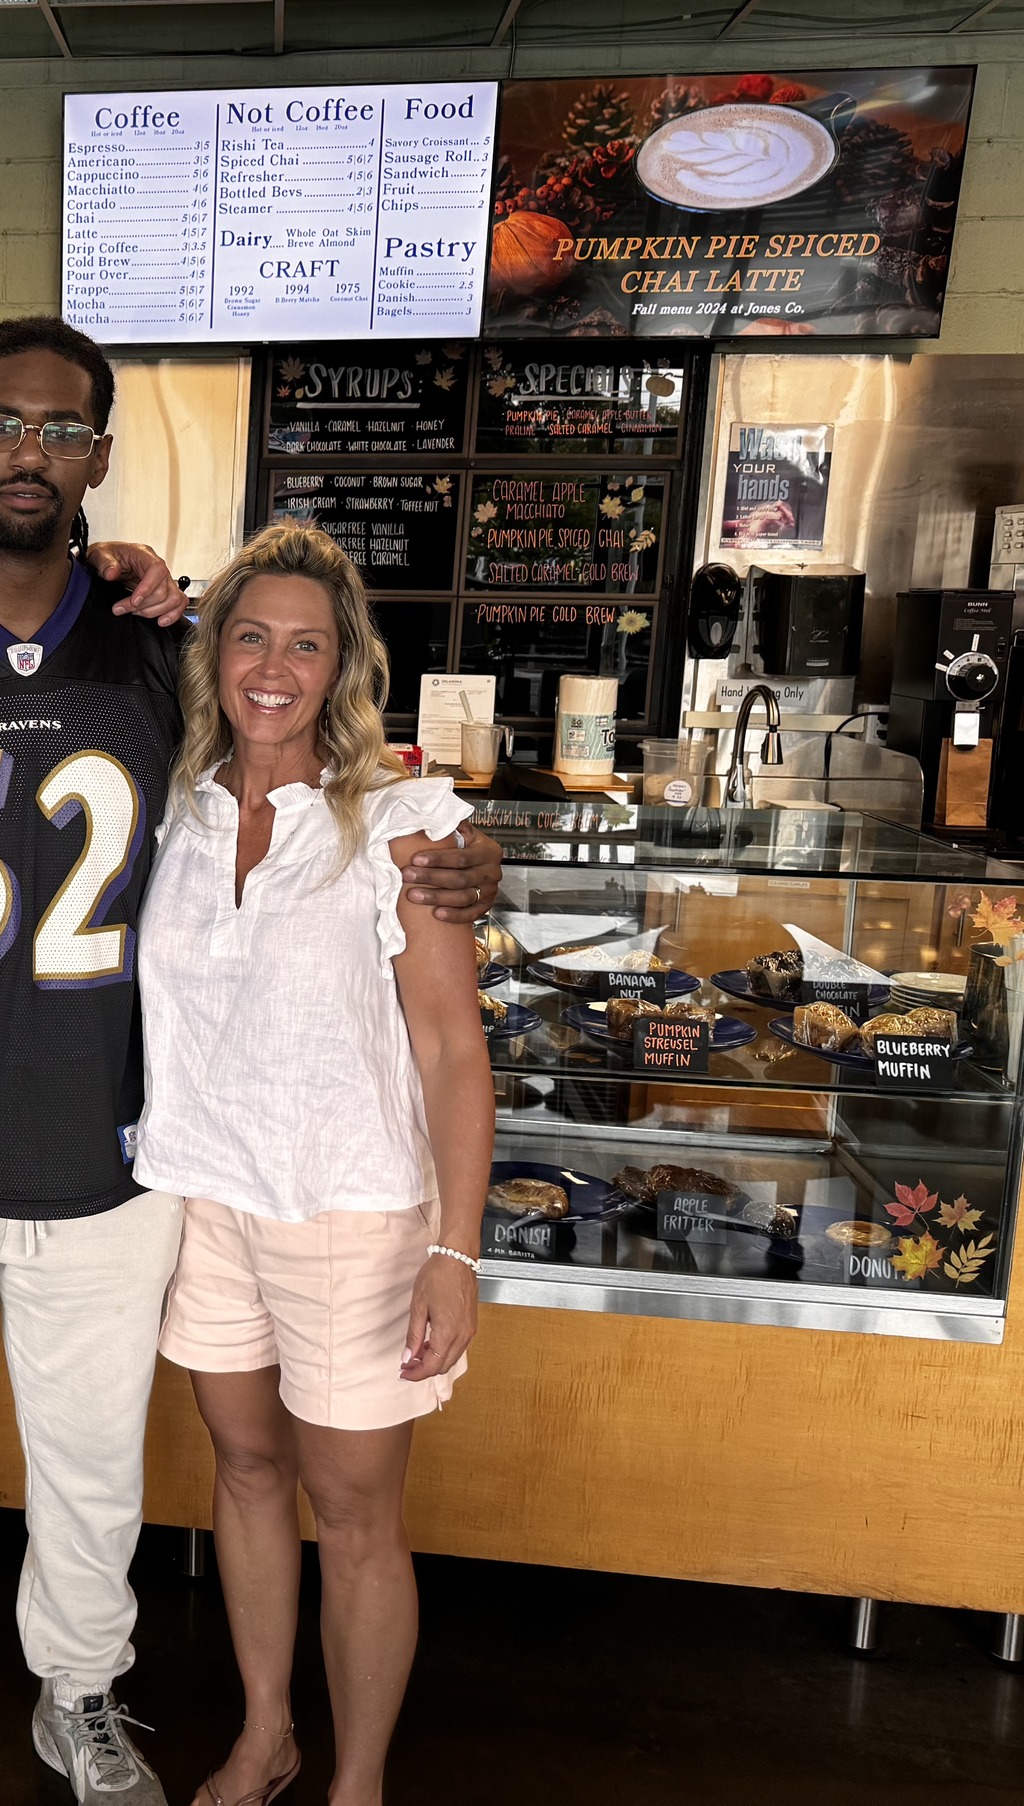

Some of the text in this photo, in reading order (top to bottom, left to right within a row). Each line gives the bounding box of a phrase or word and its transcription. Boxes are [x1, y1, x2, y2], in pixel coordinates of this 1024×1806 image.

[226, 98, 374, 124] Not Coffee
[404, 94, 474, 120] Food
[94, 105, 181, 130] Coffee
[221, 138, 284, 151] Rishi Tea
[385, 136, 490, 148] Savory Croissant 5
[68, 143, 126, 155] Espresso
[67, 156, 136, 167] Americano
[221, 154, 299, 169] Spiced Chai
[384, 150, 472, 164] Sausage Roll
[67, 169, 140, 182] Cappuccino
[220, 171, 285, 183] Refresher
[383, 167, 487, 179] Sandwich 7
[219, 186, 302, 199] Bottled Bevs
[383, 183, 415, 195] Fruit
[66, 199, 116, 210] Cortado
[218, 203, 273, 214] Steamer
[381, 199, 484, 212] Chips 2
[66, 213, 95, 224] Chai
[66, 228, 98, 239] Latte
[220, 227, 371, 249] Dairy Whole Oat Skim
[67, 243, 139, 255] Drip Coffee
[287, 238, 355, 248] Breve Almond
[384, 237, 477, 262] Pastry
[552, 233, 881, 261] PUMPKIN PIE SPICED
[66, 256, 130, 268] Cold Brew
[66, 270, 129, 281] Pour Over
[259, 260, 340, 278] CRAFT
[379, 266, 414, 276] Muffin
[378, 280, 416, 289] Cookie
[620, 269, 804, 294] CHAI LATTE
[66, 285, 109, 297] Frappe
[229, 283, 360, 296] 1992 1994 1975
[377, 293, 415, 303] Danish
[66, 300, 106, 310] Mocha
[377, 306, 412, 317] Bagels
[631, 302, 805, 317] Fall menu 2024 at Jones Co.
[66, 313, 110, 324] Matcha
[289, 419, 445, 432] VANILLA CARAMEL HAZELNUT HONEY
[549, 424, 575, 436] SALTED
[577, 424, 613, 435] CARAMEL
[306, 441, 342, 452] CHOCOLATE
[371, 441, 408, 451] CHOCOLATE
[416, 437, 455, 450] LAVENDER
[733, 463, 776, 473] YOUR
[287, 476, 423, 489] BLUEBERRY COCONUT BROWN SUGAR
[737, 474, 790, 501] hands
[492, 479, 586, 503] CARAMEL APPLE
[287, 497, 439, 512] IRISH CREAM STRAWBERRY TOFFEE NUT
[505, 503, 566, 520] MACCHIATO
[371, 522, 404, 536] VANILLA
[369, 538, 410, 551] HAZELNUT
[487, 528, 624, 549] PUMPKIN PIE SPICED CHAI
[371, 551, 410, 566] CARAMEL
[488, 562, 639, 584] SALTED CARAMEL COLD BREW
[476, 603, 616, 625] PUMPKIN PIE COLD BREW
[721, 685, 744, 697] Hand
[784, 686, 804, 701] Only
[608, 973, 657, 988] BANANA
[812, 981, 847, 990] DOUBLE
[620, 990, 643, 999] NUT
[815, 990, 859, 1000] CHOCOLATE
[649, 1022, 700, 1039] PUMPKIN
[644, 1037, 699, 1051] STREUSEL
[877, 1040, 950, 1058] BLUEBERRY
[644, 1053, 691, 1067] MUFFIN
[877, 1060, 931, 1080] MUFFIN
[674, 1197, 708, 1214] APPLE
[663, 1215, 715, 1232] FRITTER
[494, 1223, 551, 1247] DANISH
